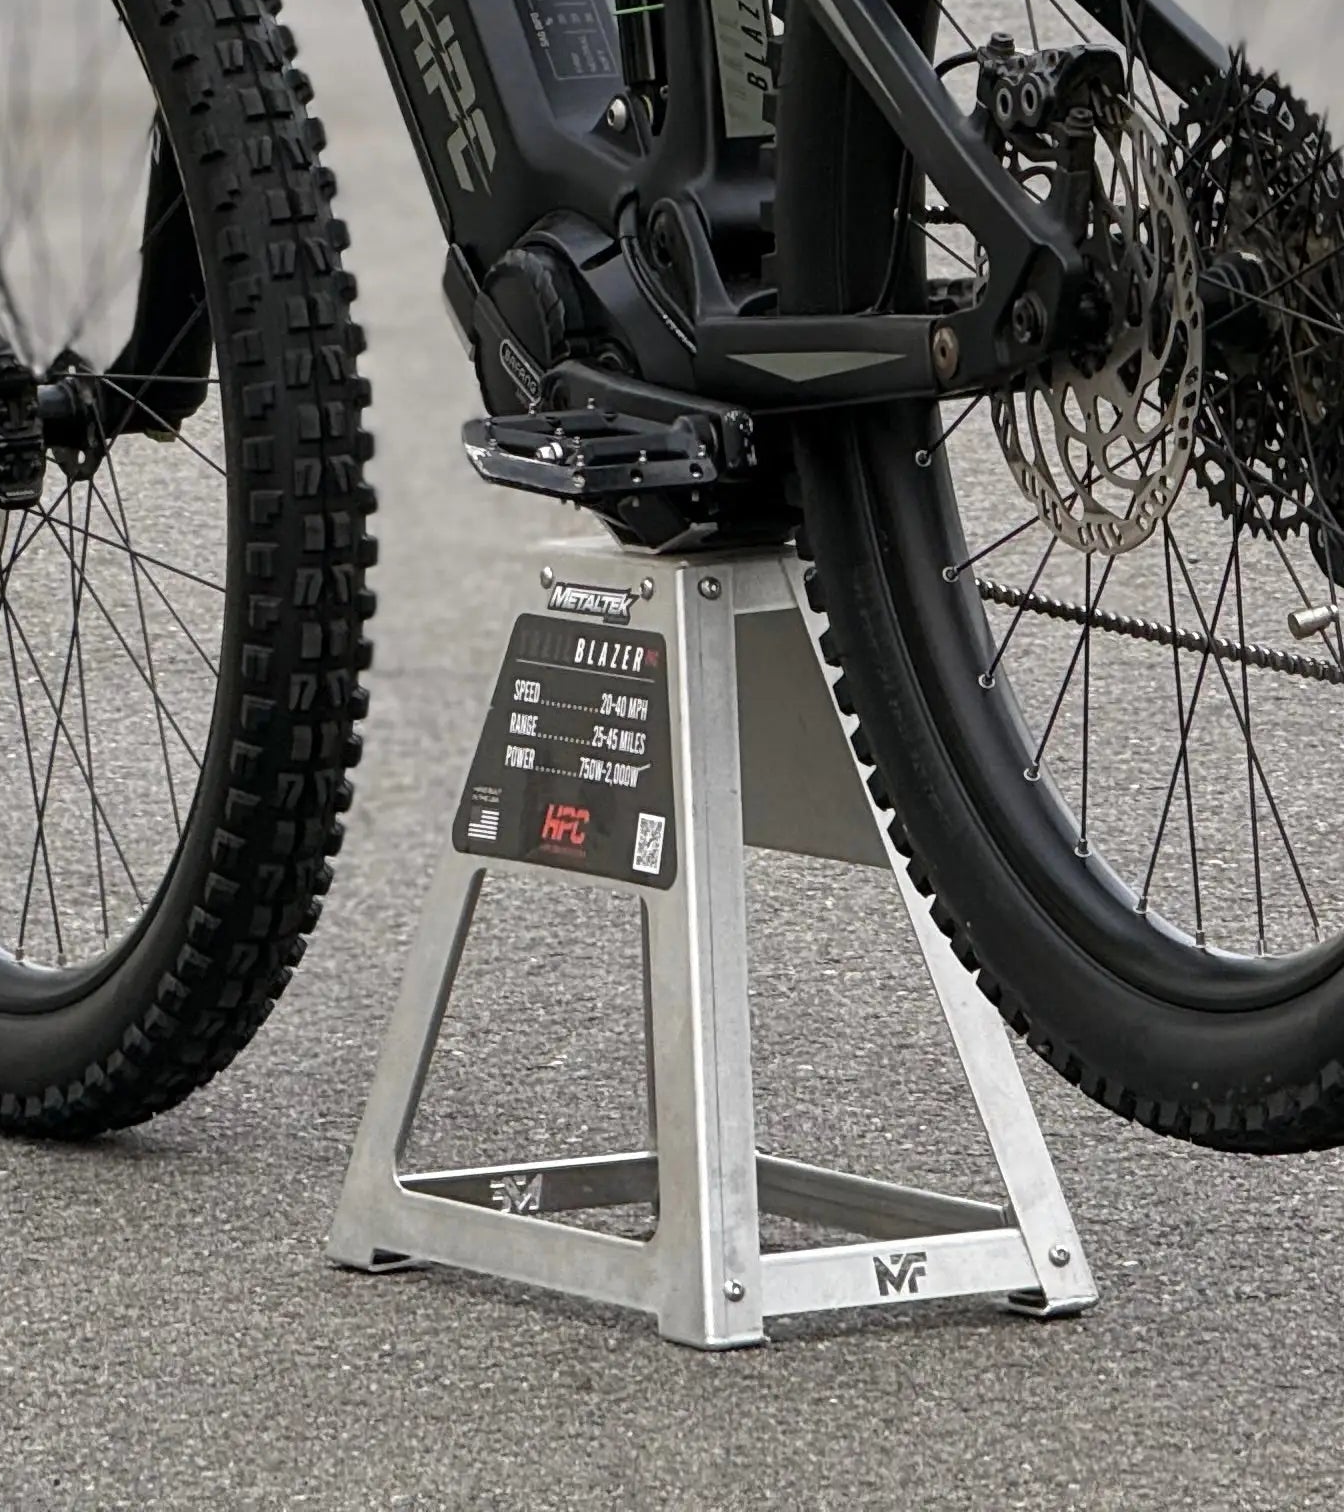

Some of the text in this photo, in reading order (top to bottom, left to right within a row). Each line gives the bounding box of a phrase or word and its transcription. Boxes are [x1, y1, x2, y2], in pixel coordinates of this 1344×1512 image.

[504, 347, 537, 395] BAFANG
[550, 585, 634, 617] METALTEK
[574, 638, 645, 672] BLAZER
[513, 679, 649, 721] SPEED 20-40 MPH
[509, 712, 646, 755] RANGE 25-45 MILES
[505, 744, 640, 788] POWER 750W-2,000W
[542, 803, 590, 845] HPC
